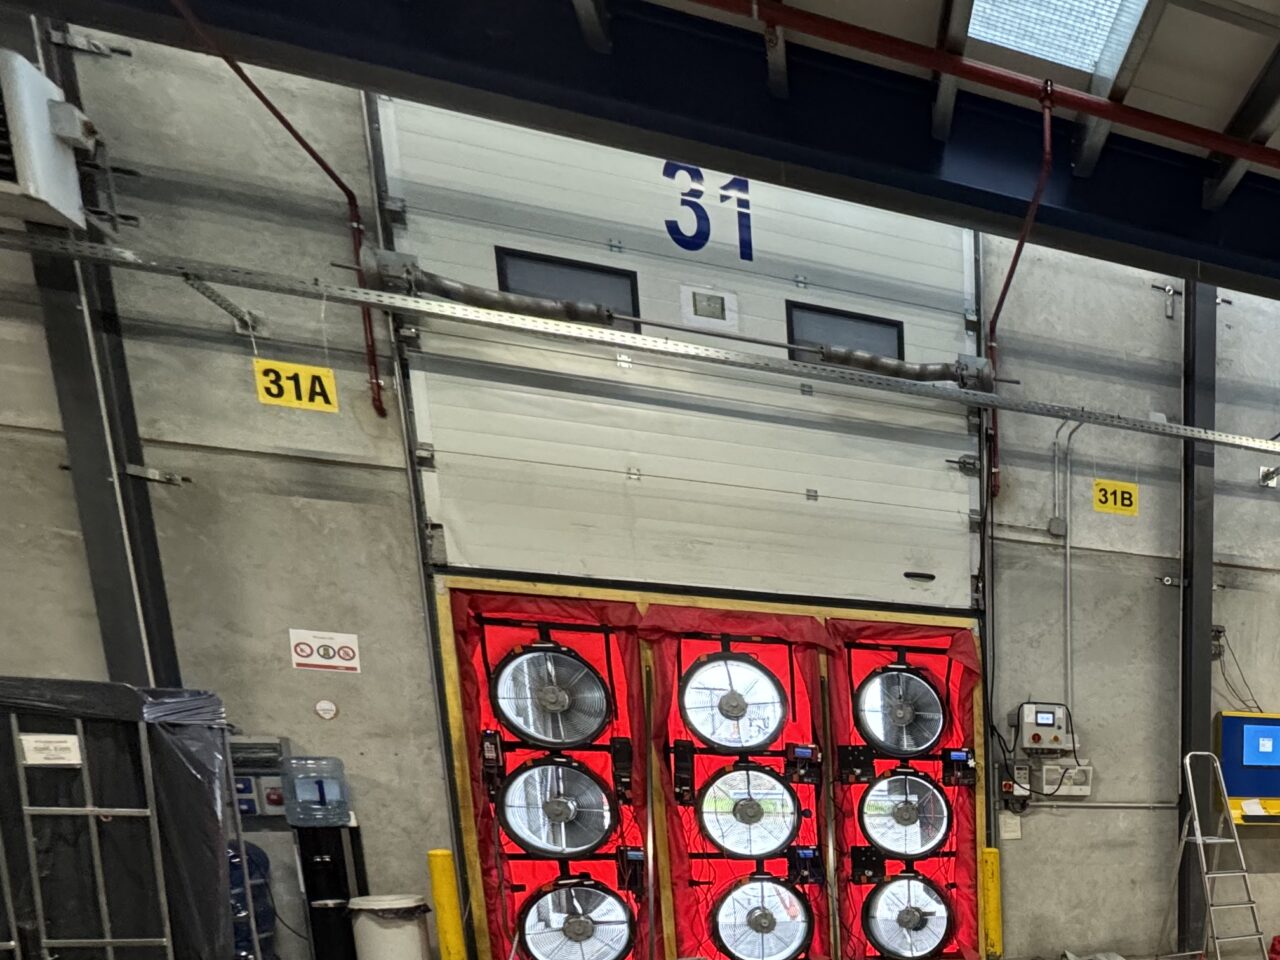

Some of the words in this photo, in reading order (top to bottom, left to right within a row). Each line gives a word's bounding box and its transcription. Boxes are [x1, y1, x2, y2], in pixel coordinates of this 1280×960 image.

[663, 160, 753, 261] 31
[262, 368, 332, 405] 31A
[1098, 488, 1133, 507] 31B
